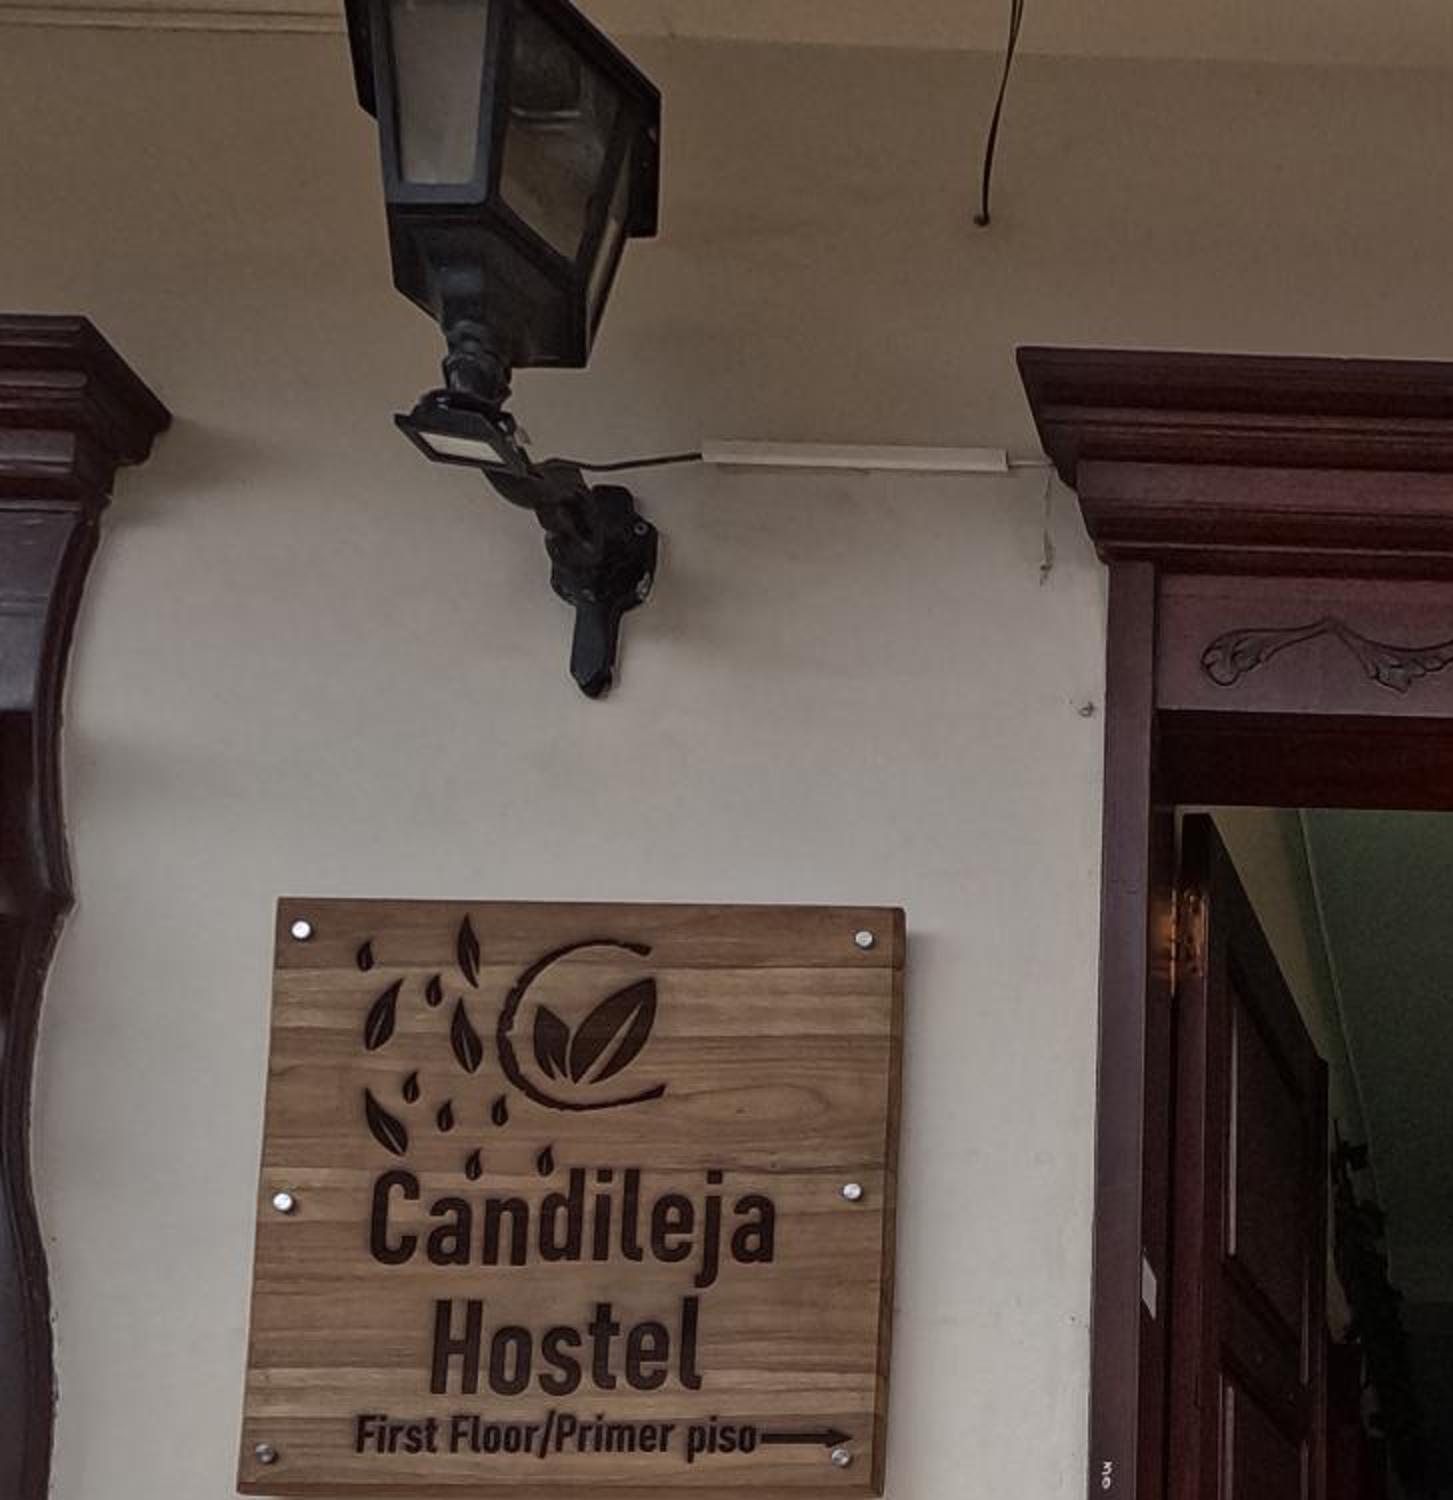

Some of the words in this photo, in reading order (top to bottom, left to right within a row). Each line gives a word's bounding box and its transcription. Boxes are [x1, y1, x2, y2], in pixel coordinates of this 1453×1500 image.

[368, 1167, 777, 1289] Candileja
[429, 1295, 703, 1397] Hostel
[355, 1414, 439, 1455] First
[448, 1408, 676, 1459] Floor/Primer
[686, 1414, 760, 1464] piso
